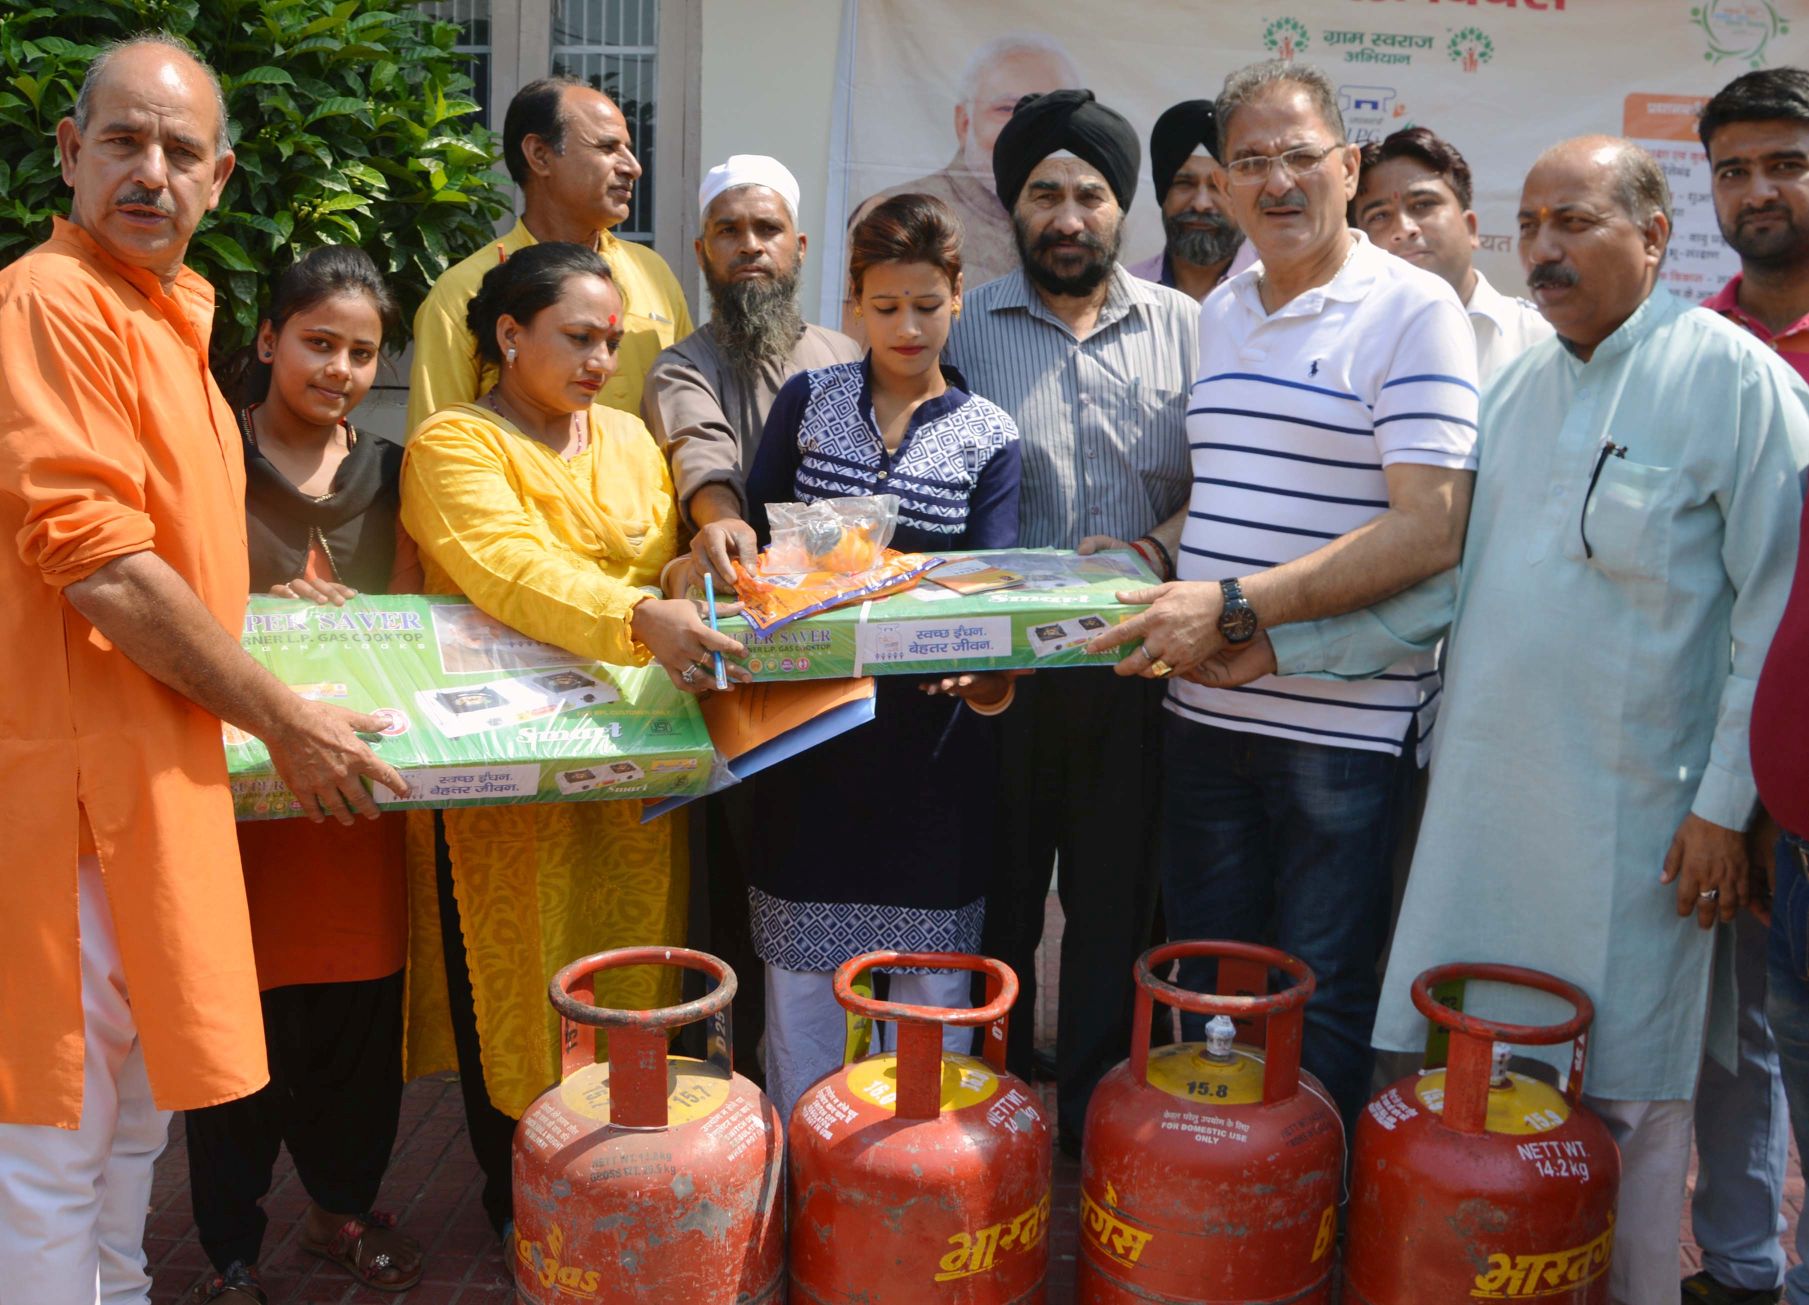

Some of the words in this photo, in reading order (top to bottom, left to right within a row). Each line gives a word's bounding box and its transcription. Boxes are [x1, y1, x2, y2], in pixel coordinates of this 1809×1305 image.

[1323, 29, 1365, 46] ग्राम
[1371, 32, 1435, 49] स्वराज
[1344, 48, 1411, 65] अभियान
[318, 610, 425, 632] SAVER
[317, 633, 350, 643] GAS
[351, 632, 424, 643] COOKTOP
[780, 629, 832, 643] SAVER
[916, 629, 949, 640] स्वच्छ
[908, 641, 948, 655] बेहतर
[439, 774, 474, 784] स्वच्छ
[430, 784, 471, 796] बेहतर
[673, 1084, 713, 1108] 15.7
[1187, 1081, 1228, 1098] 15.8
[1161, 1122, 1179, 1131] FOR
[1181, 1122, 1227, 1138] DOMESTIC
[1229, 1131, 1248, 1143] USE
[1195, 1134, 1220, 1145] ONLY
[1517, 1142, 1559, 1160] NETT
[1570, 1161, 1589, 1182] kg
